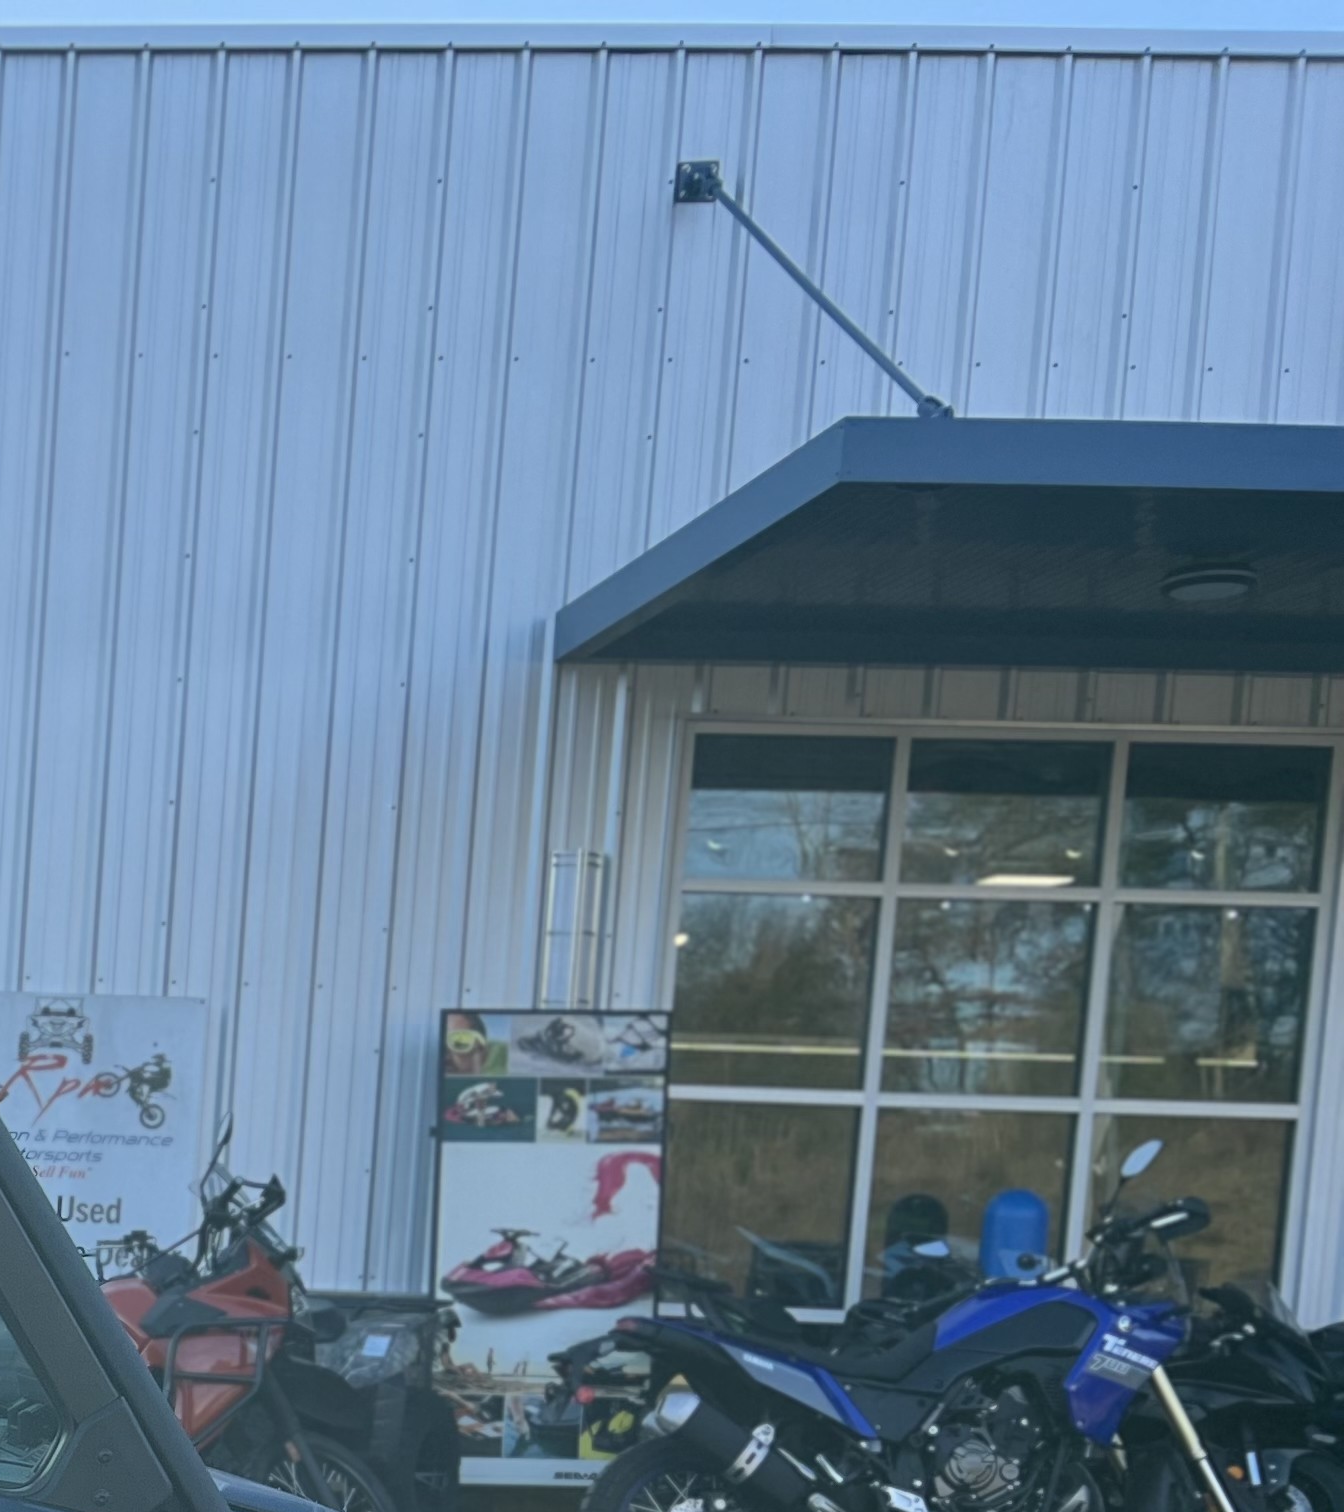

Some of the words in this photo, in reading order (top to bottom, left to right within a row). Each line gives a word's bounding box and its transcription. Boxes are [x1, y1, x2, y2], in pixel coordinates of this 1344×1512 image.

[34, 1130, 47, 1142] &
[52, 1129, 174, 1147] Performance
[56, 1195, 123, 1225] Used
